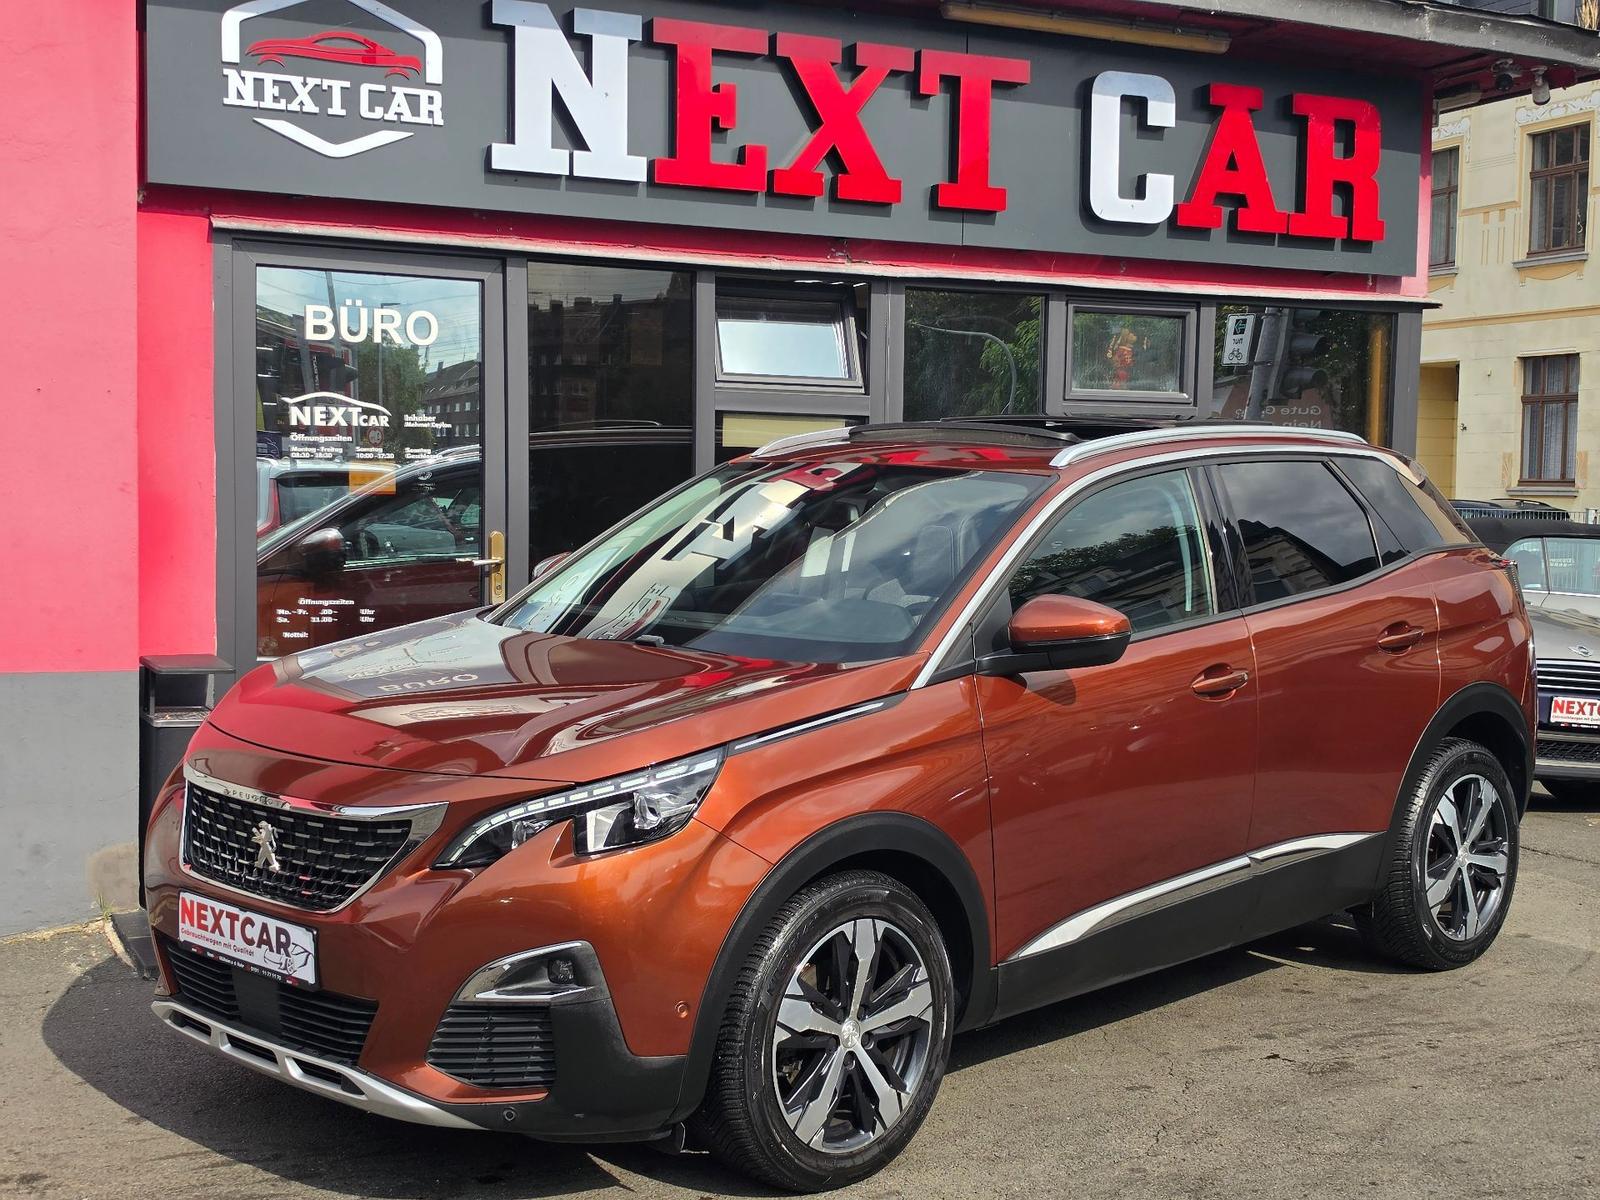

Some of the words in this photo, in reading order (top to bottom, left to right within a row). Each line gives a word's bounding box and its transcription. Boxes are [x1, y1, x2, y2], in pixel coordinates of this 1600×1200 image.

[222, 68, 350, 117] NEXT
[359, 82, 444, 126] CAR
[490, 0, 1031, 213] NEXT
[1089, 70, 1386, 243] CAR
[304, 298, 439, 346] BÜRO
[290, 432, 352, 443] Öffnungszeiten
[298, 598, 354, 606] Öffnungszeiten
[180, 896, 292, 958] NEXTCAR
[223, 941, 232, 951] mit
